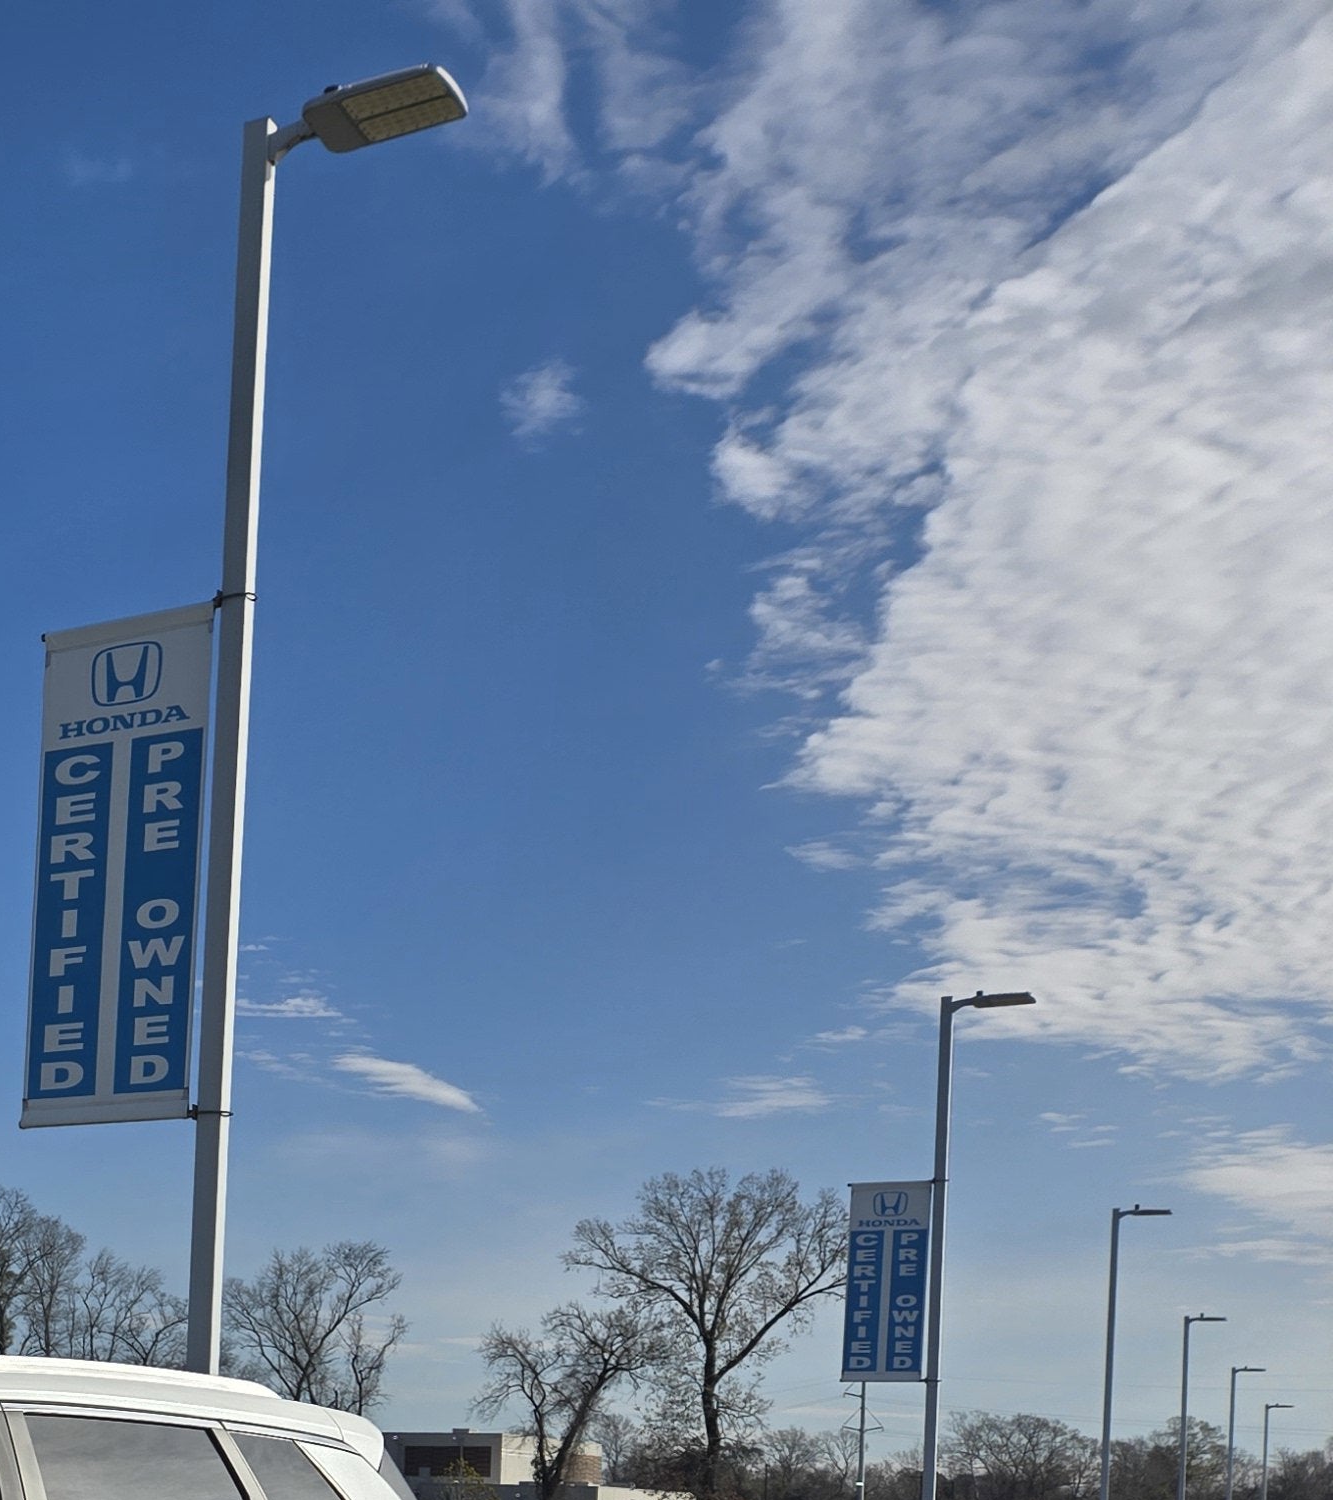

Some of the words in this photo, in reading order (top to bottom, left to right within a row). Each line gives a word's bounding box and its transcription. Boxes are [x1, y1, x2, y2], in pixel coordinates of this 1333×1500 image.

[58, 704, 190, 740] HONDA
[142, 740, 185, 853] PRE
[39, 754, 101, 1092] CERTIFIED
[128, 898, 186, 1085] OWNED
[858, 1218, 920, 1228] HONDA
[898, 1232, 919, 1277] PRE
[848, 1233, 879, 1370] CERTIFIED
[892, 1294, 920, 1369] OWNED
